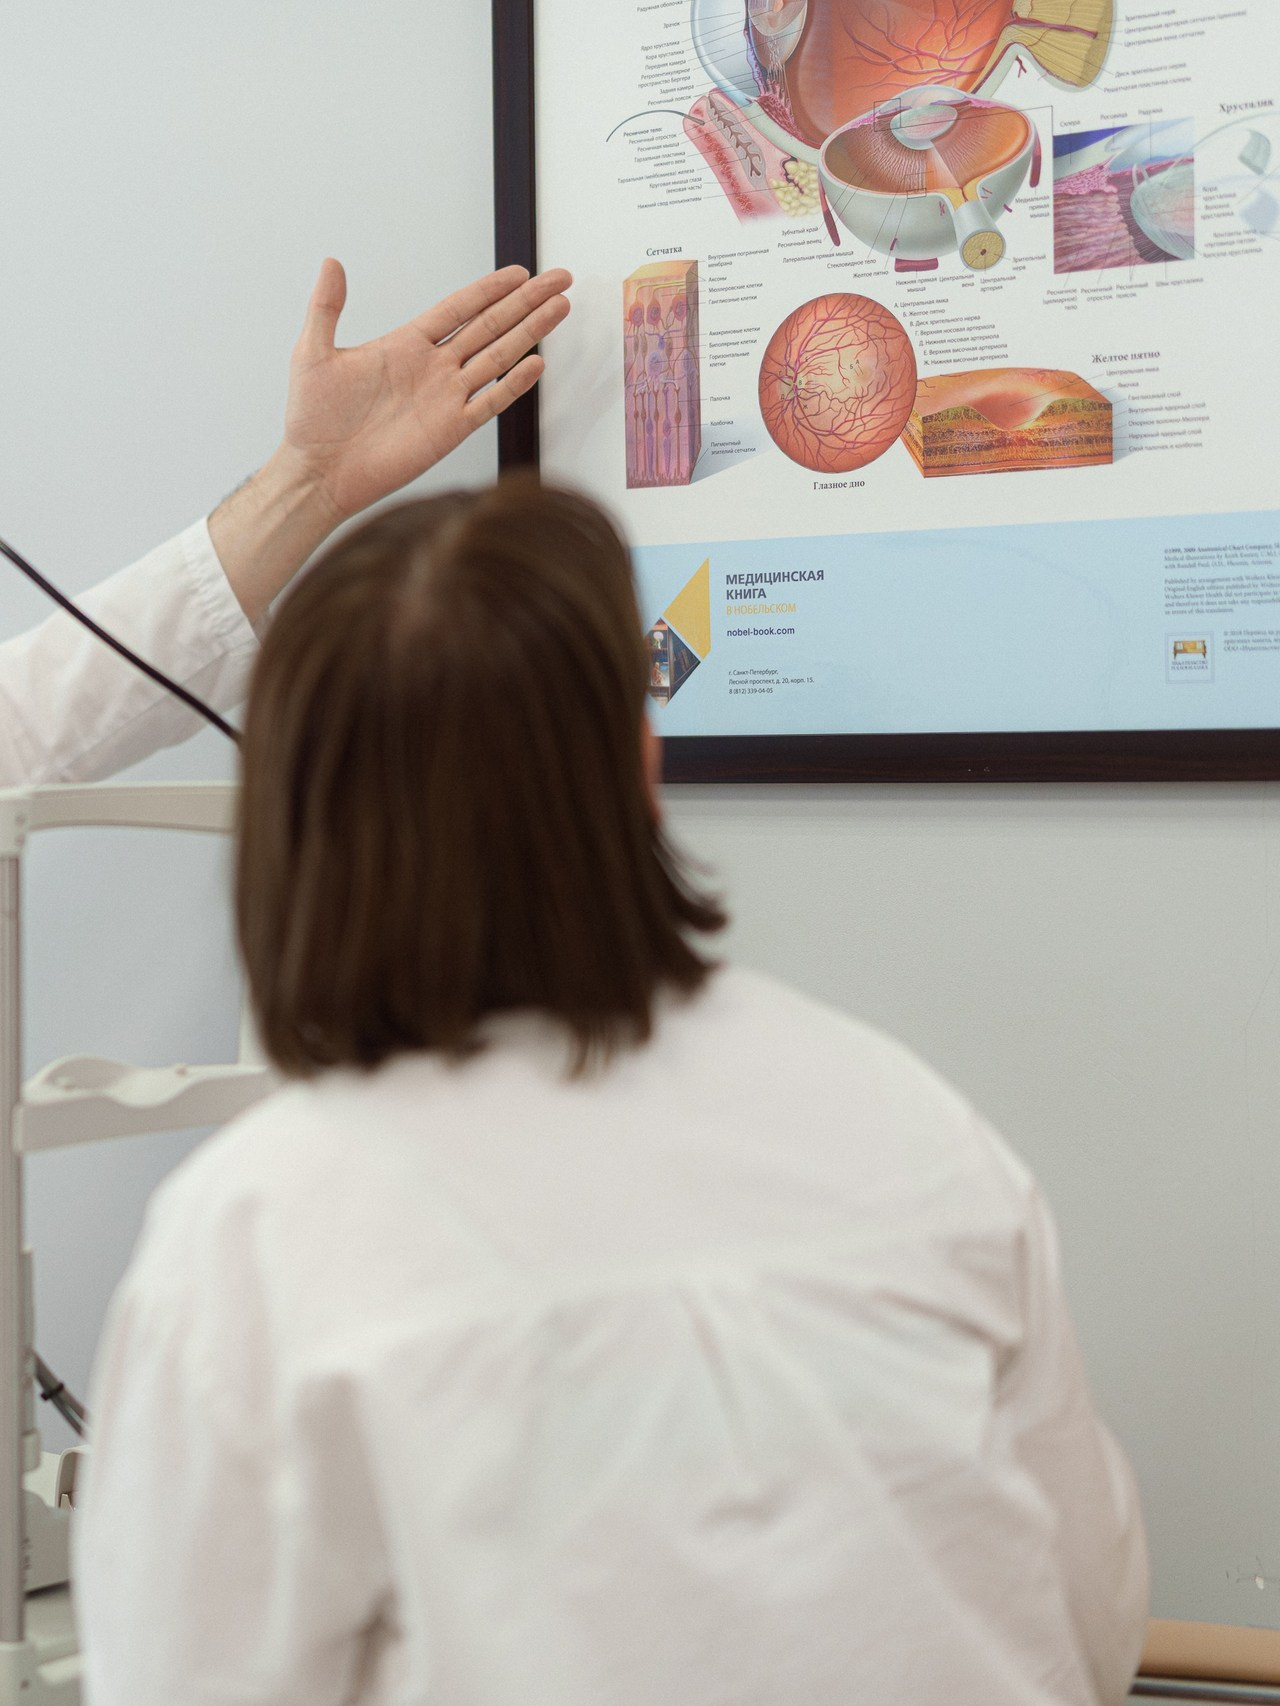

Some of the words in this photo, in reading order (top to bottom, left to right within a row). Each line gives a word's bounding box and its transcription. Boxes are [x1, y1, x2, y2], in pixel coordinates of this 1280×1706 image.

[646, 246, 682, 257] Сетчатка
[1092, 354, 1128, 364] Желтое
[1130, 351, 1160, 360] пятно
[813, 482, 848, 490] Глазное
[726, 570, 824, 586] МЕДИЦИНСКАЯ
[726, 588, 767, 600] КНИГА
[726, 605, 732, 616] В
[734, 603, 796, 616] НОБЕЛЬСКОМ
[726, 627, 795, 636] nobel-book.com
